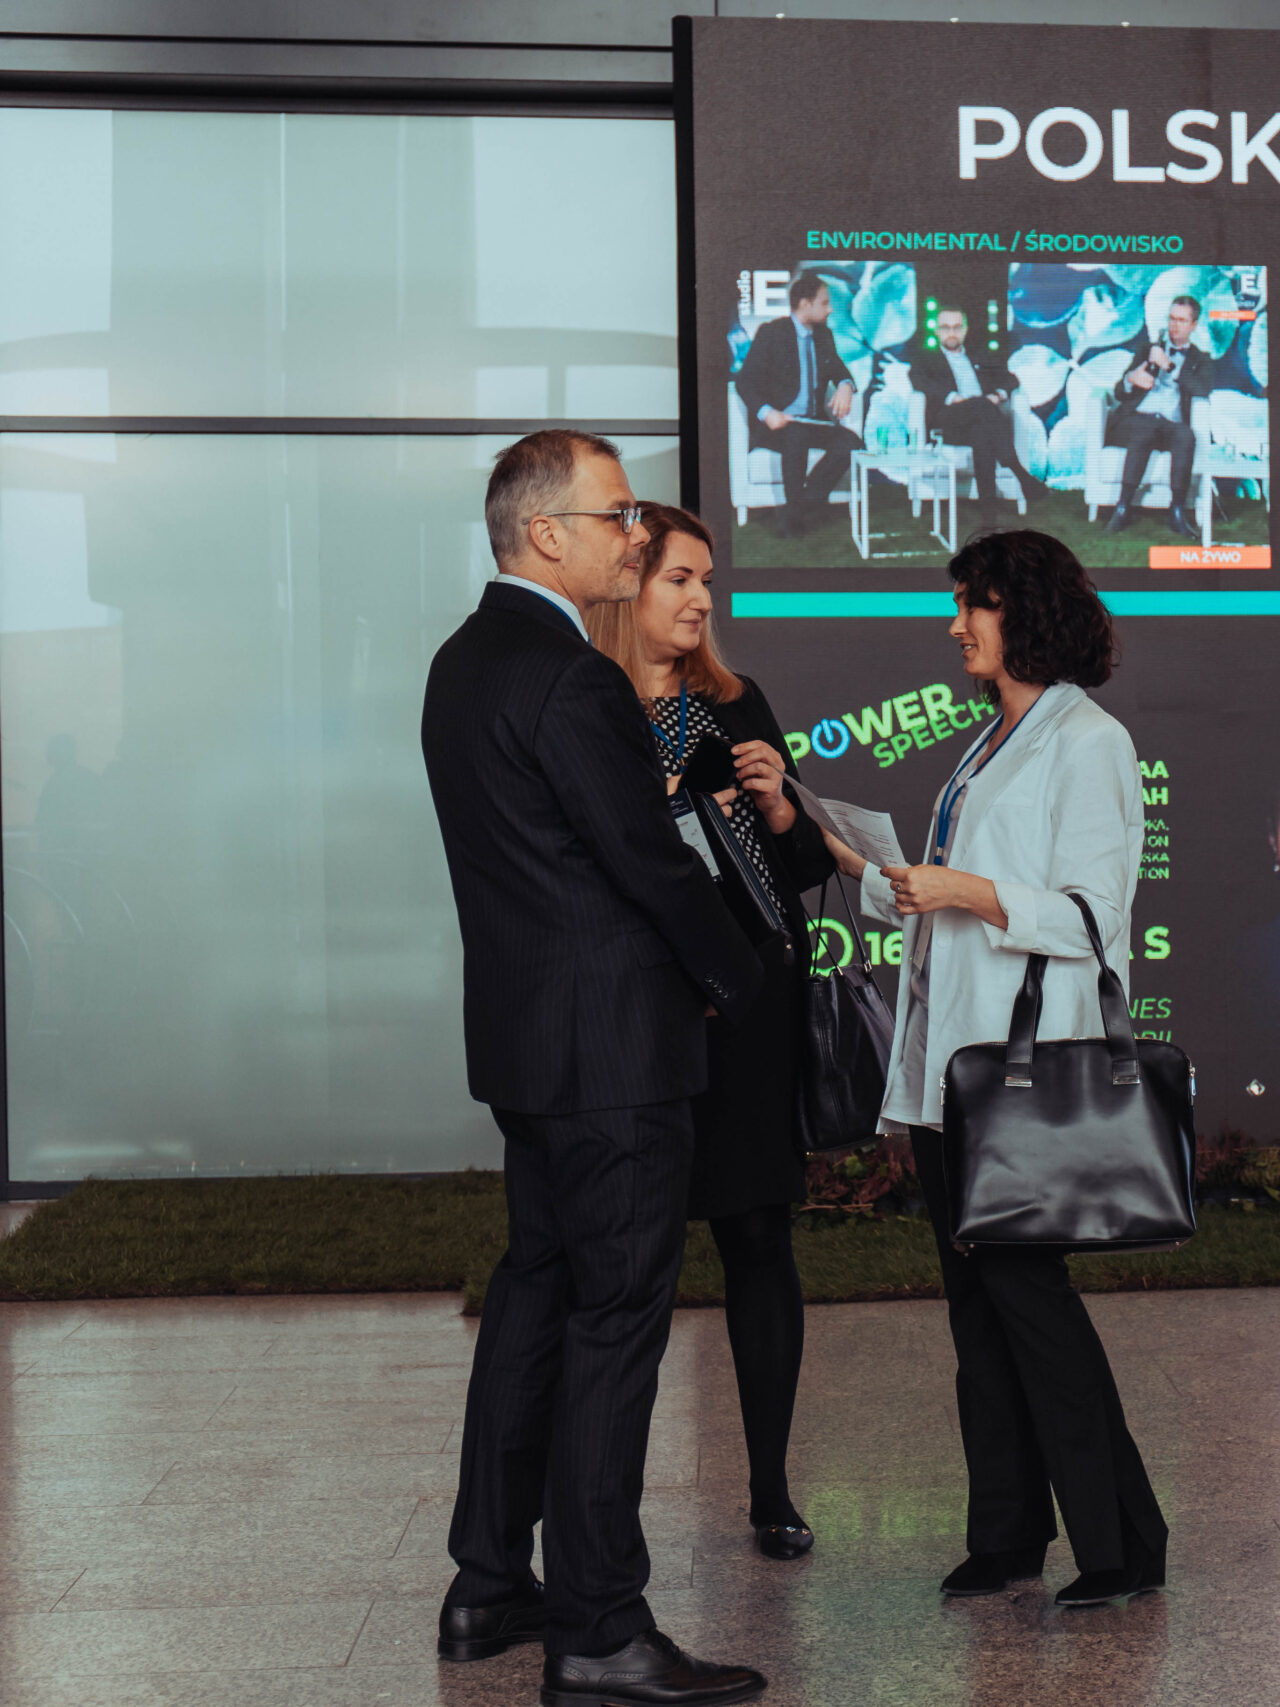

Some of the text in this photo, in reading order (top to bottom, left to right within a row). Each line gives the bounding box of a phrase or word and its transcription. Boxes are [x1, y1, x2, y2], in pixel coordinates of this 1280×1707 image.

[806, 231, 1006, 252] ENVIRONMENTAL
[1024, 230, 1184, 253] ŚRODOWISKO
[737, 270, 791, 316] studio E
[1180, 551, 1200, 563] NA
[873, 694, 996, 769] SPEECH
